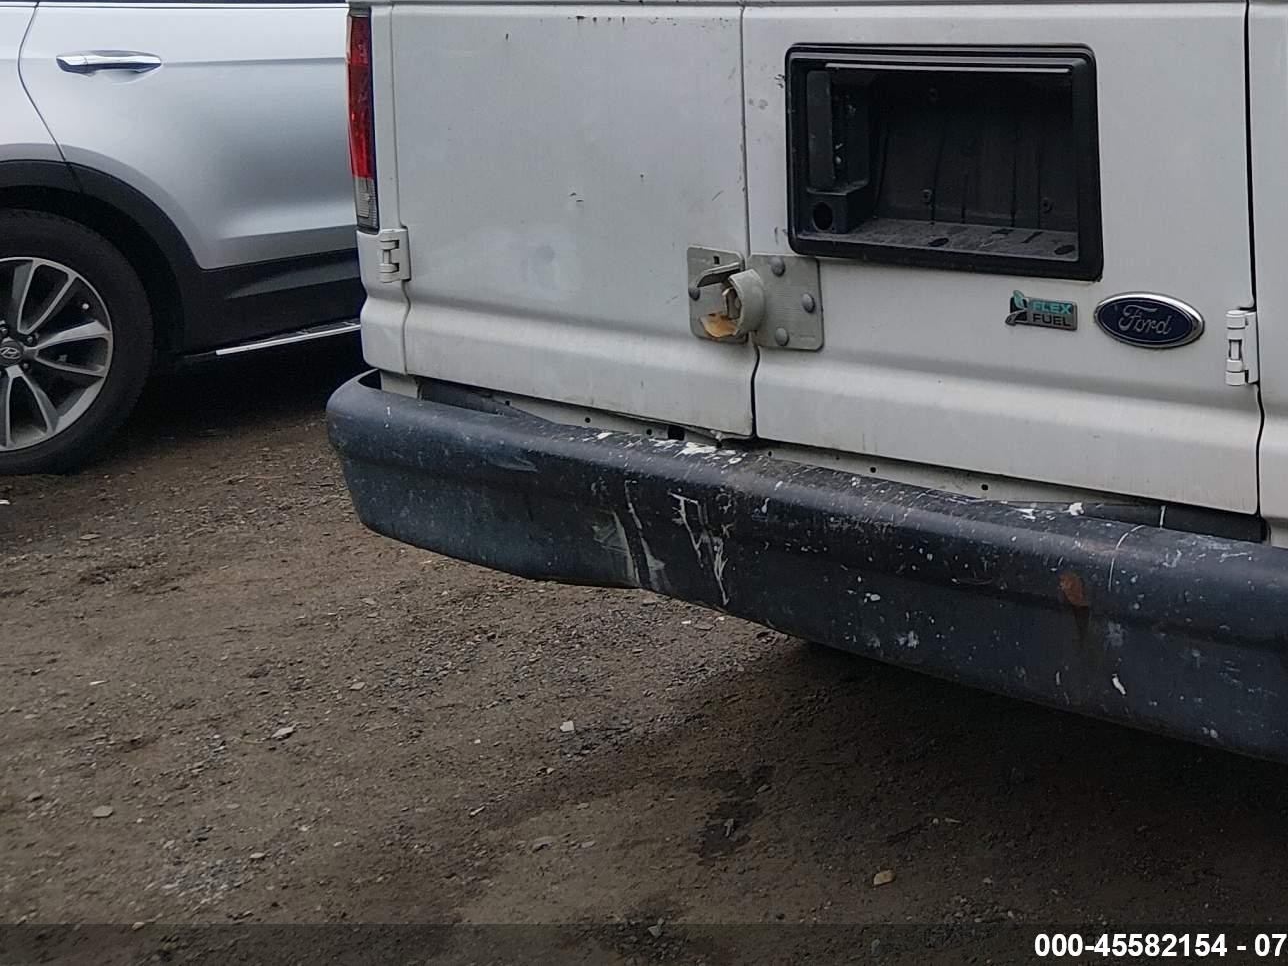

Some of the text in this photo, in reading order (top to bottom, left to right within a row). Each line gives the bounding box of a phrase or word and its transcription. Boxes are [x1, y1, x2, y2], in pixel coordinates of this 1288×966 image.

[1032, 301, 1073, 315] FLEX
[1032, 313, 1072, 328] FUEL
[1118, 304, 1172, 336] Ford
